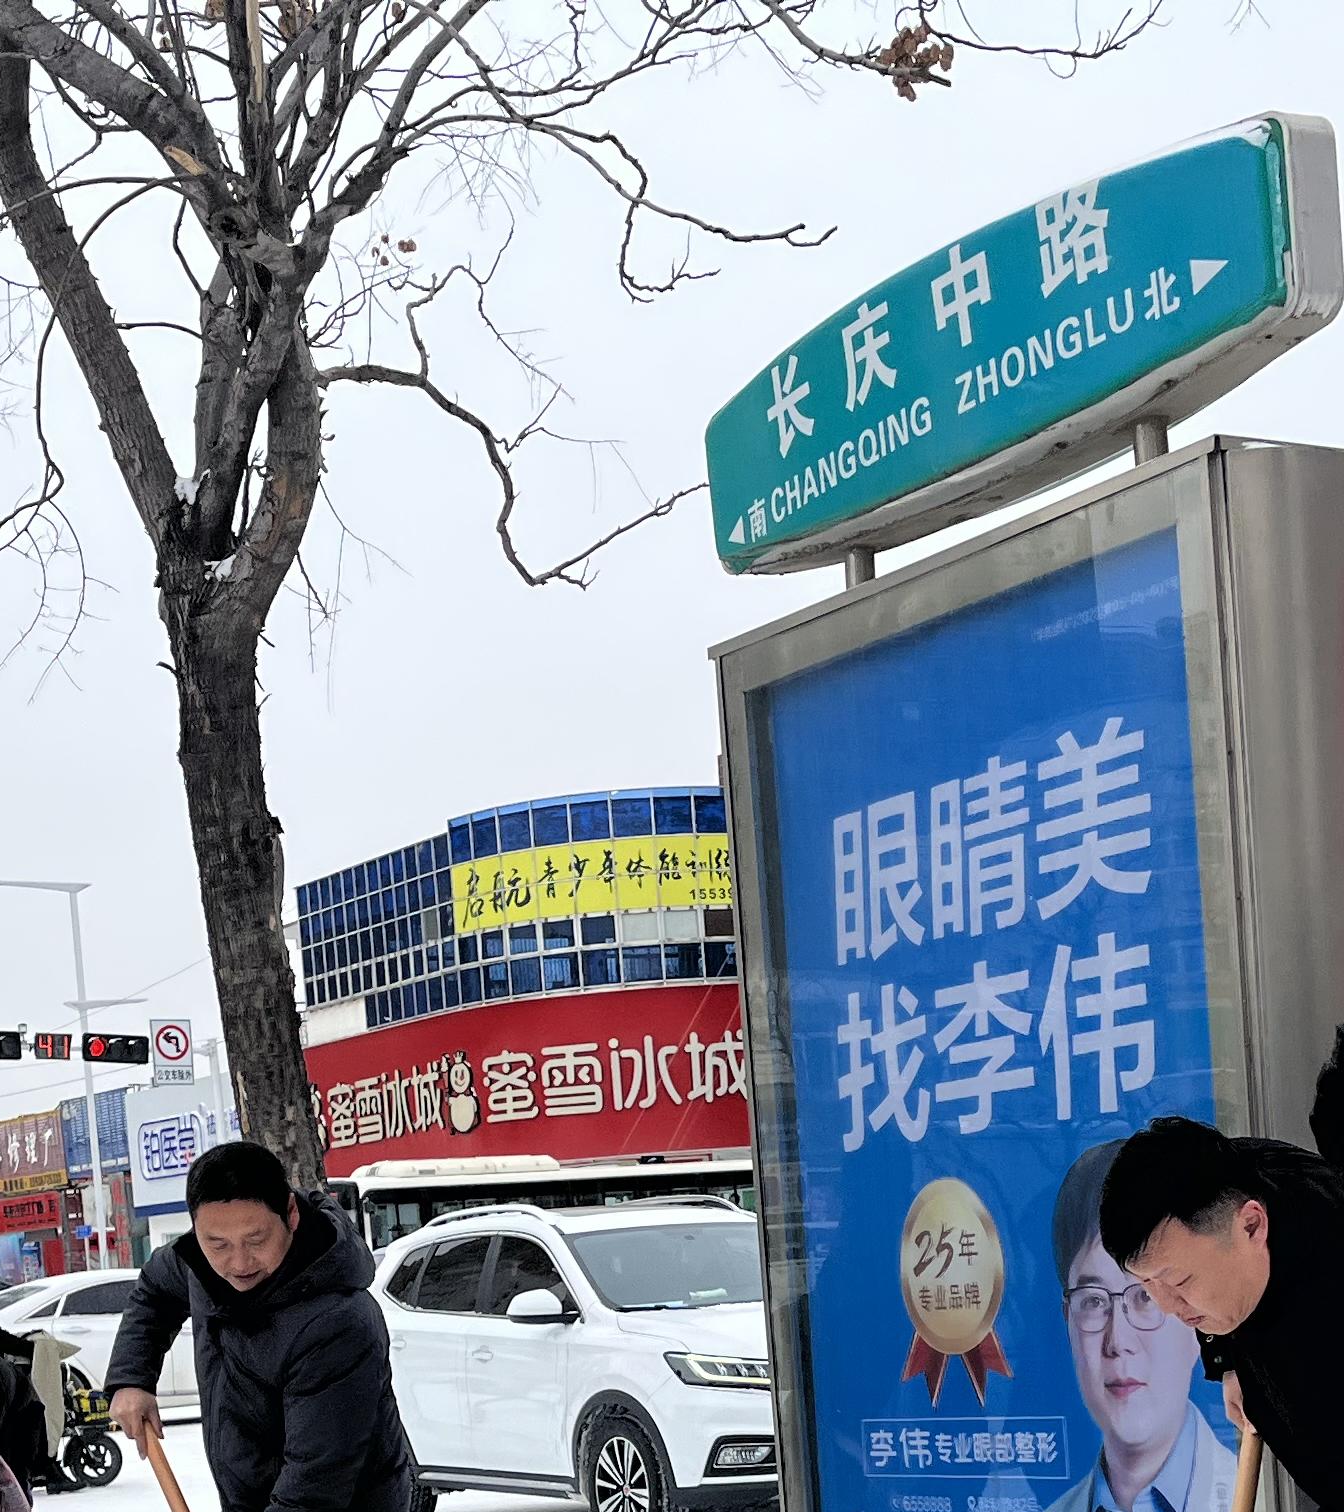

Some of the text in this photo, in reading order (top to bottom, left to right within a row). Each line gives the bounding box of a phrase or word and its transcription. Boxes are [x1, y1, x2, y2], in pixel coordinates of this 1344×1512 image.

[766, 179, 1110, 460] 长庆中路
[1144, 267, 1181, 322] 北
[771, 287, 1135, 524] CHANGQING ZHONGLU
[747, 496, 767, 544] 南
[833, 717, 1152, 967] 眼睛美
[36, 1033, 70, 1060] 41
[482, 1029, 749, 1124] 蜜雪冰城
[837, 932, 1155, 1153] 找李伟
[327, 1064, 445, 1149] 蜜雪冰城
[913, 1222, 979, 1279] 25年
[919, 1282, 982, 1312] 专业品牌
[869, 1427, 1058, 1469] 李伟专业眼部整形
